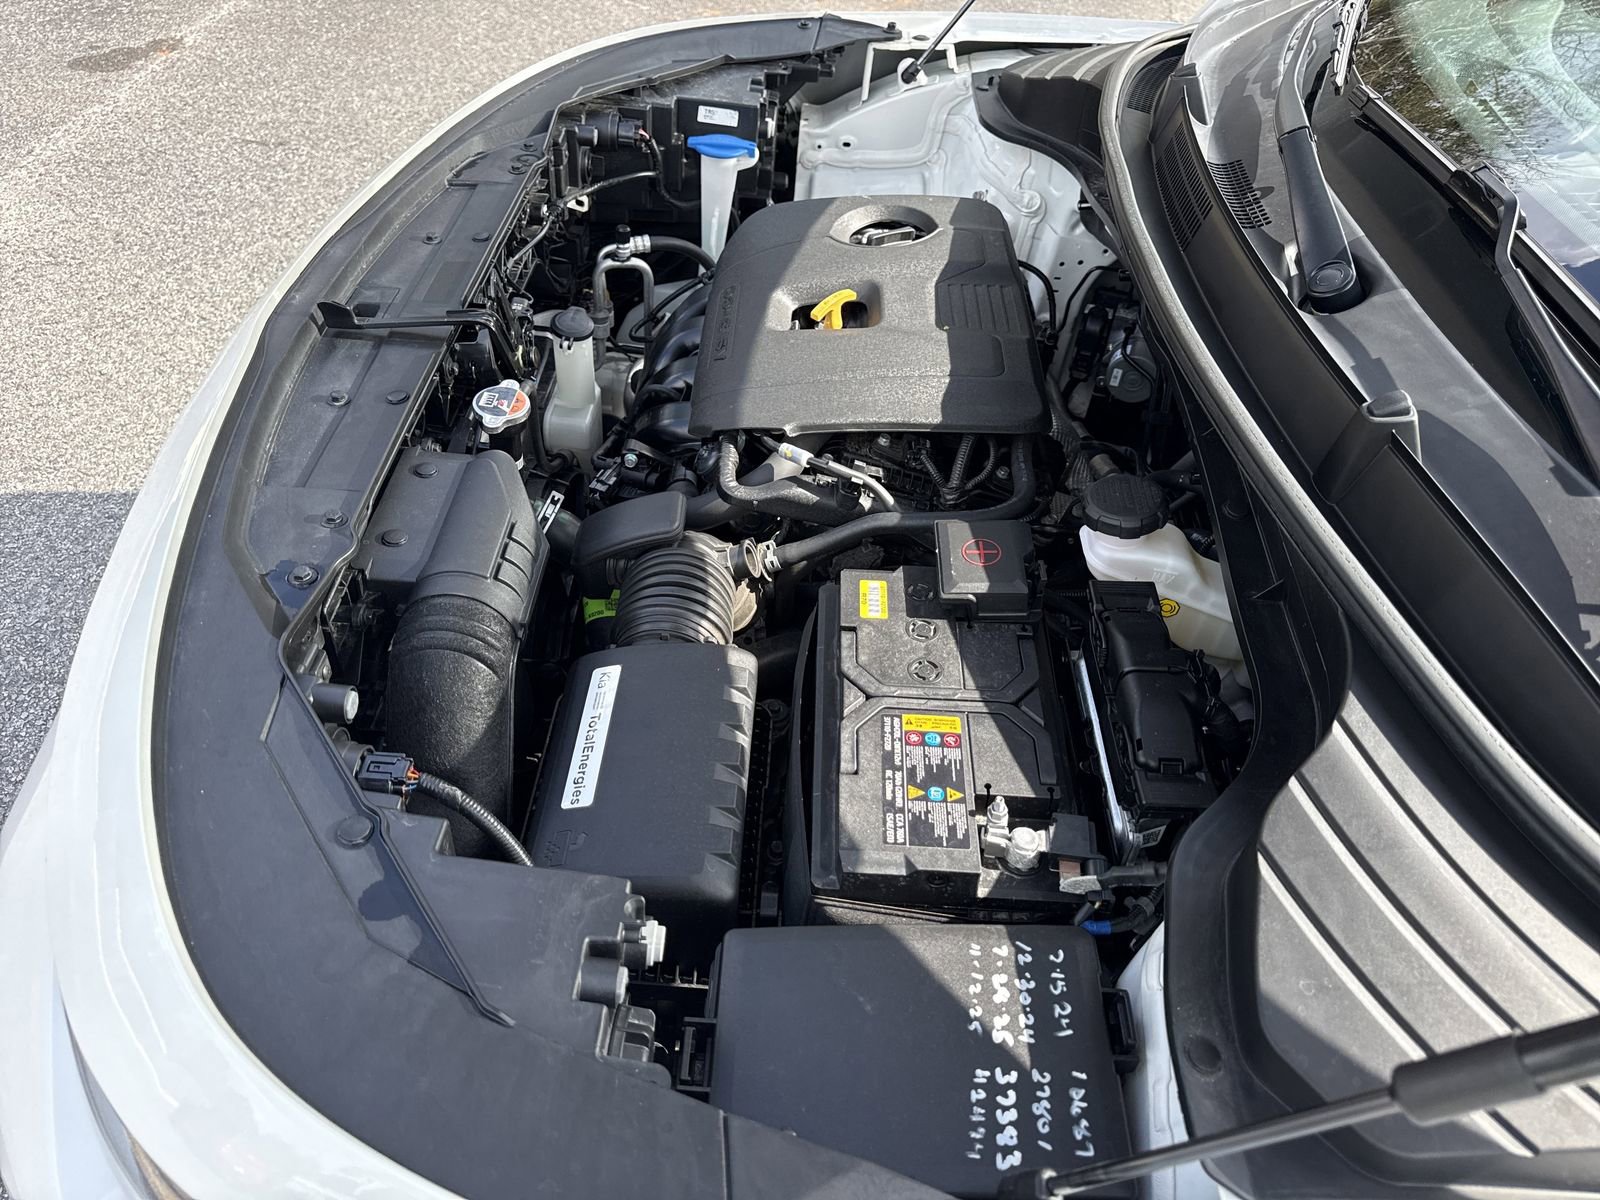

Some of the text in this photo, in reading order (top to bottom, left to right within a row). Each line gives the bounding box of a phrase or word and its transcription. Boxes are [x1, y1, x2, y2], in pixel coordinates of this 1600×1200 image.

[597, 671, 612, 689] Kia
[570, 712, 602, 806] TotalEnergies
[895, 813, 904, 827] CCA
[994, 1066, 1022, 1170] 37383
[1031, 1067, 1053, 1151] 27801
